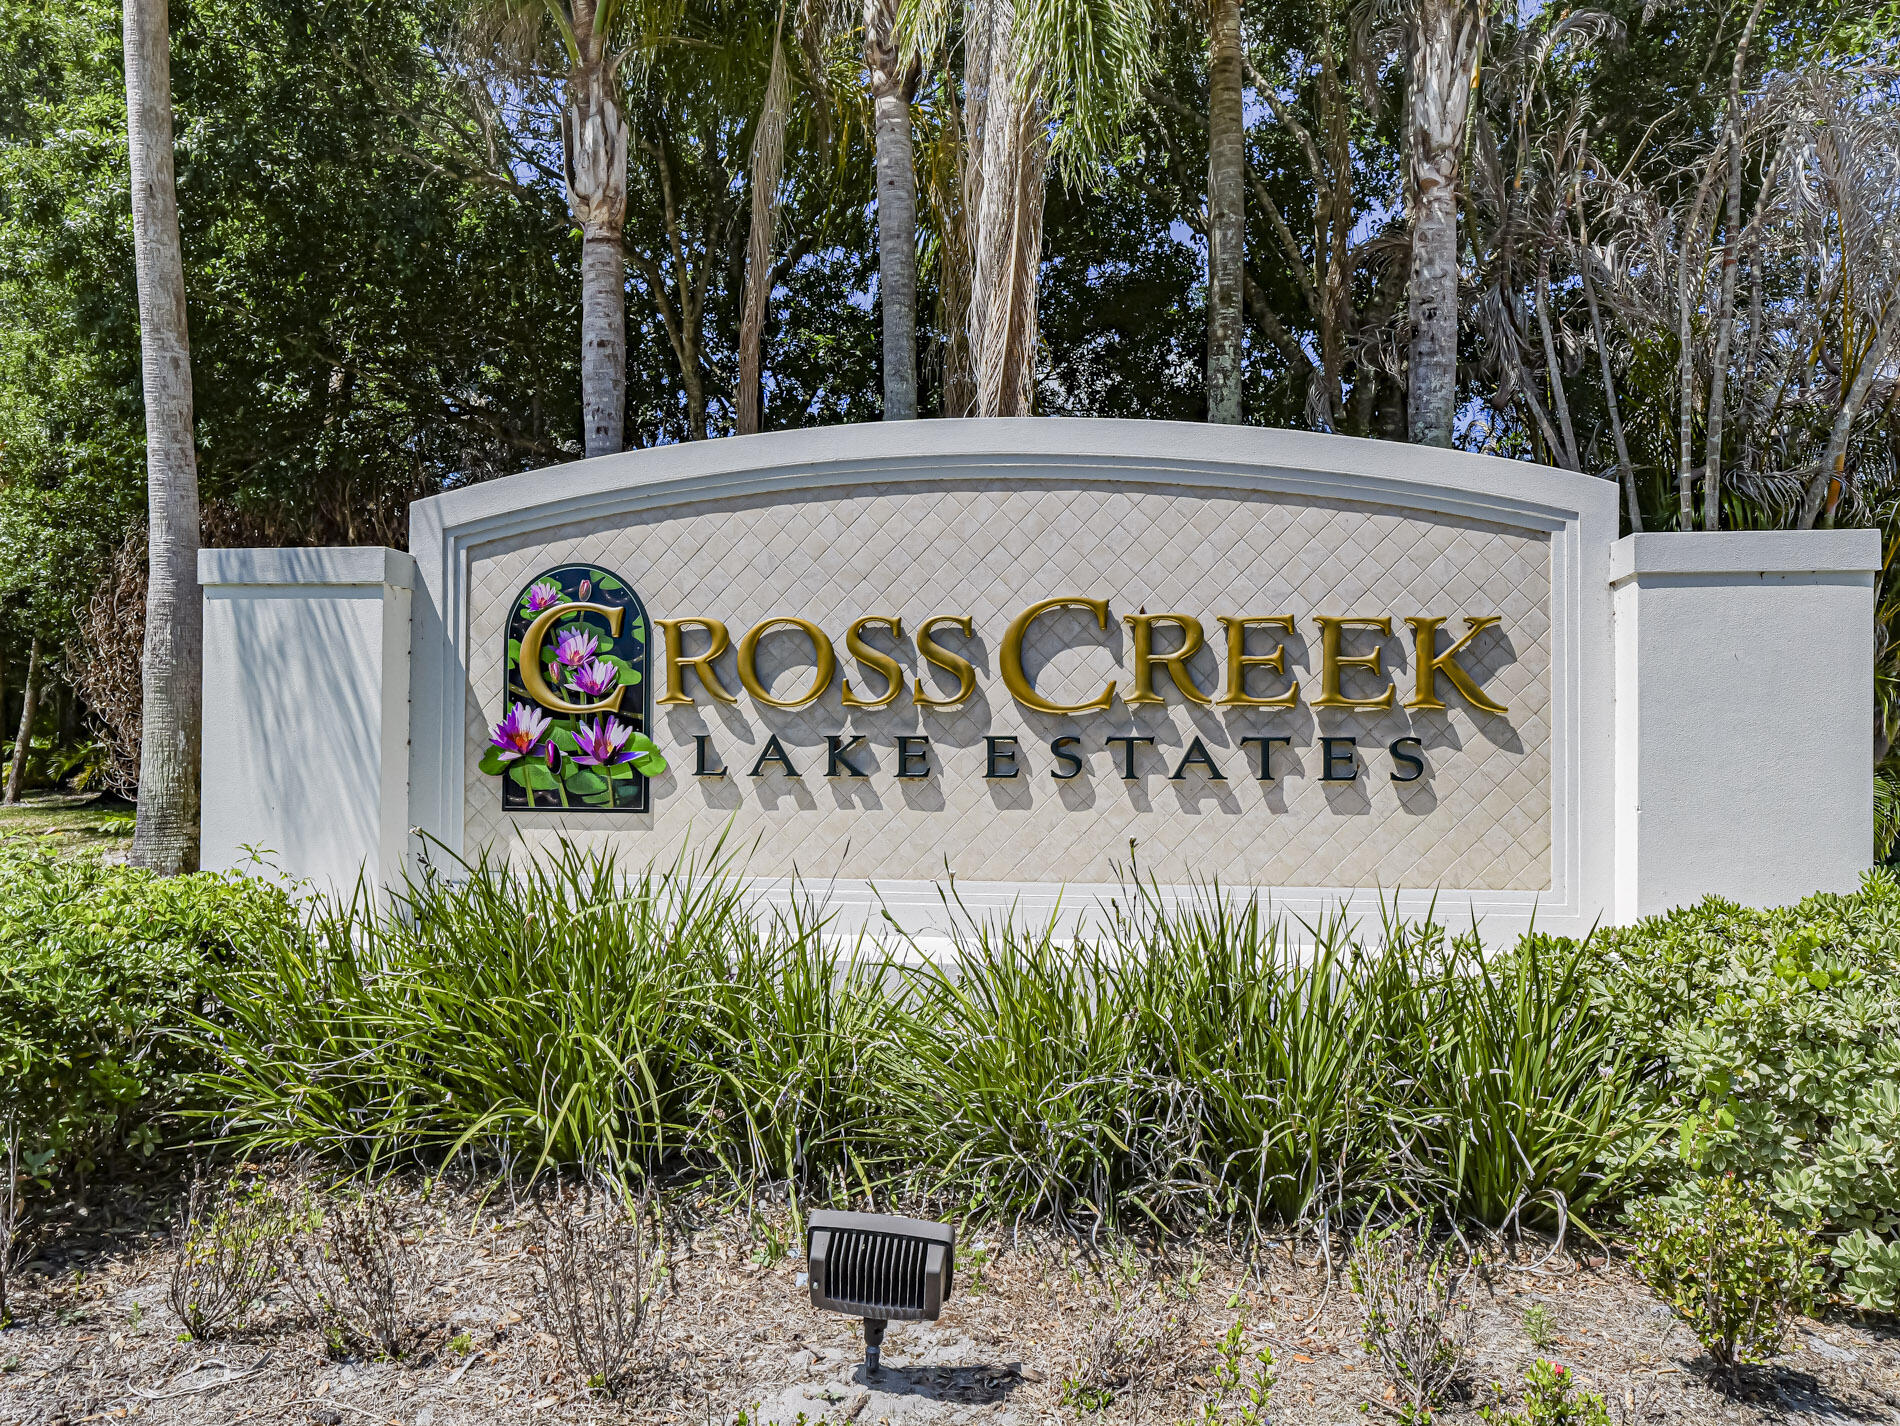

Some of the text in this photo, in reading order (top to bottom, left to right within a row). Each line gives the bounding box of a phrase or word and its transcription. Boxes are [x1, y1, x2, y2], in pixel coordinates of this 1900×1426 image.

[519, 597, 1509, 714] CROSS CREEK
[691, 733, 1425, 783] LAKE ESTATES
